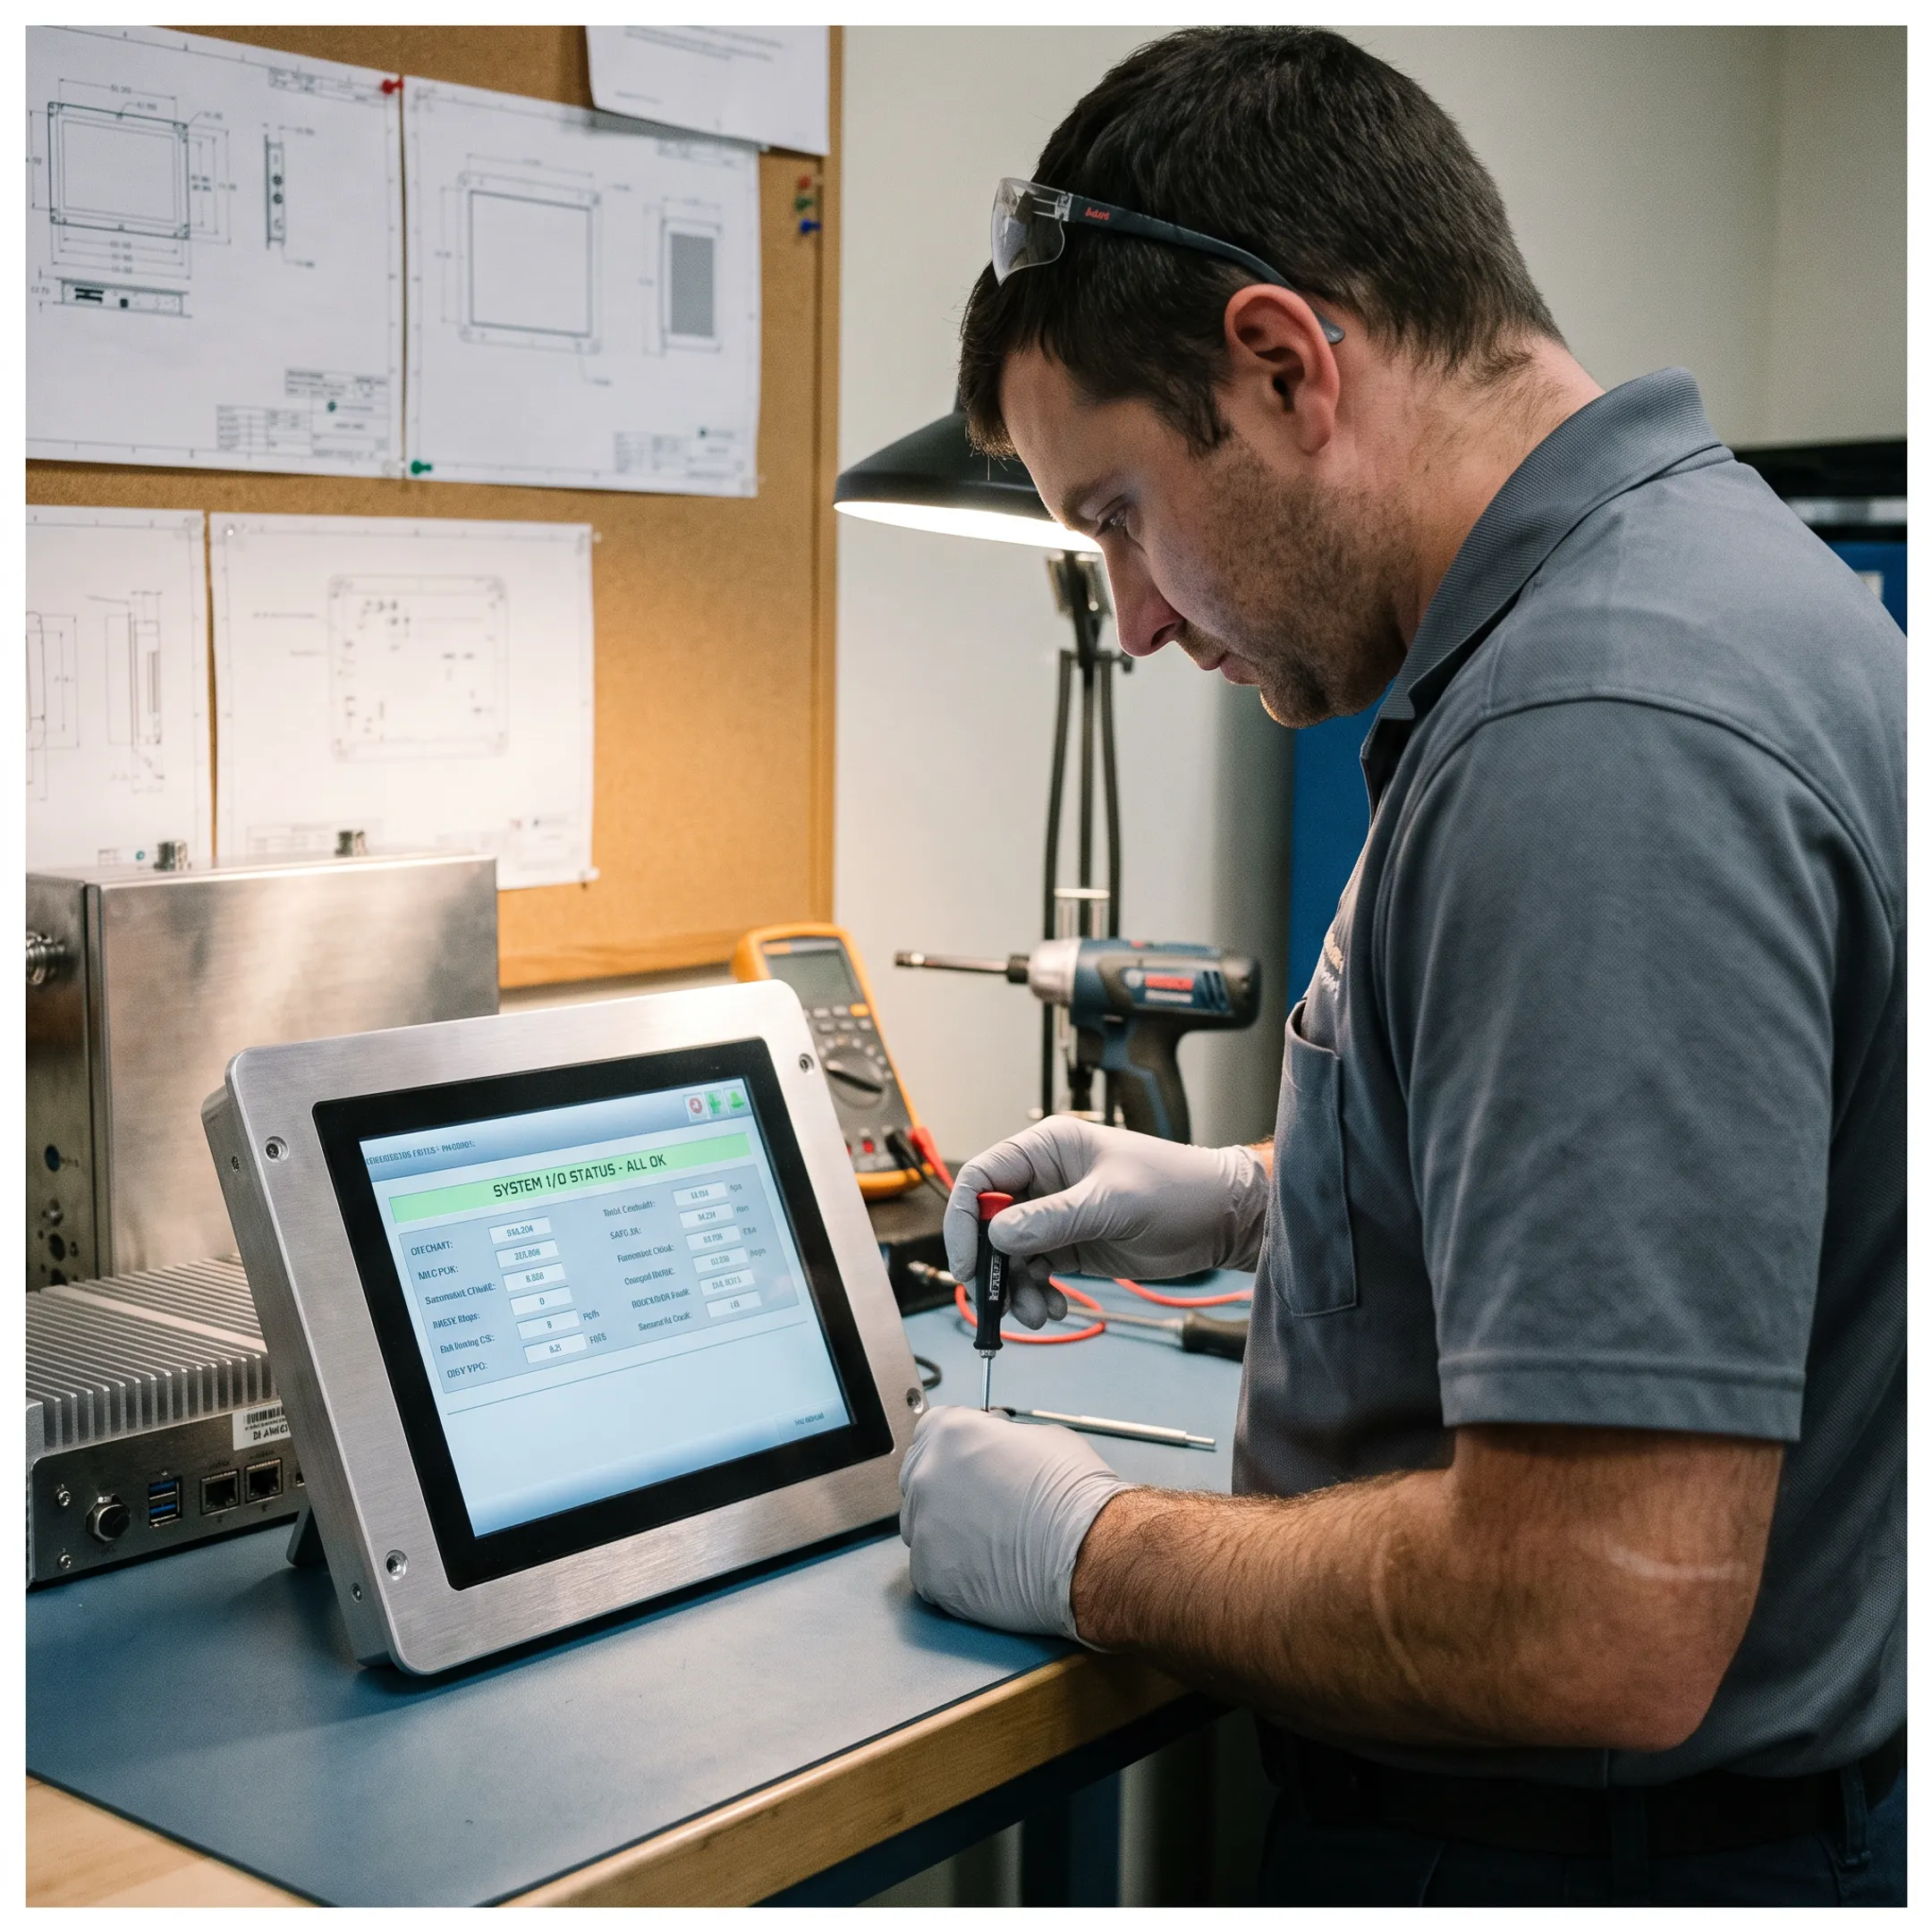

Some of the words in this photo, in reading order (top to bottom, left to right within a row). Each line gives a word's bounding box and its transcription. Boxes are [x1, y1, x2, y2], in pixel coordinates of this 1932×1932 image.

[493, 1176, 542, 1198] SYSTEM
[570, 1163, 616, 1183] STATUS
[626, 1157, 647, 1173] ALL
[649, 1154, 667, 1167] OK
[539, 1297, 545, 1306] 0
